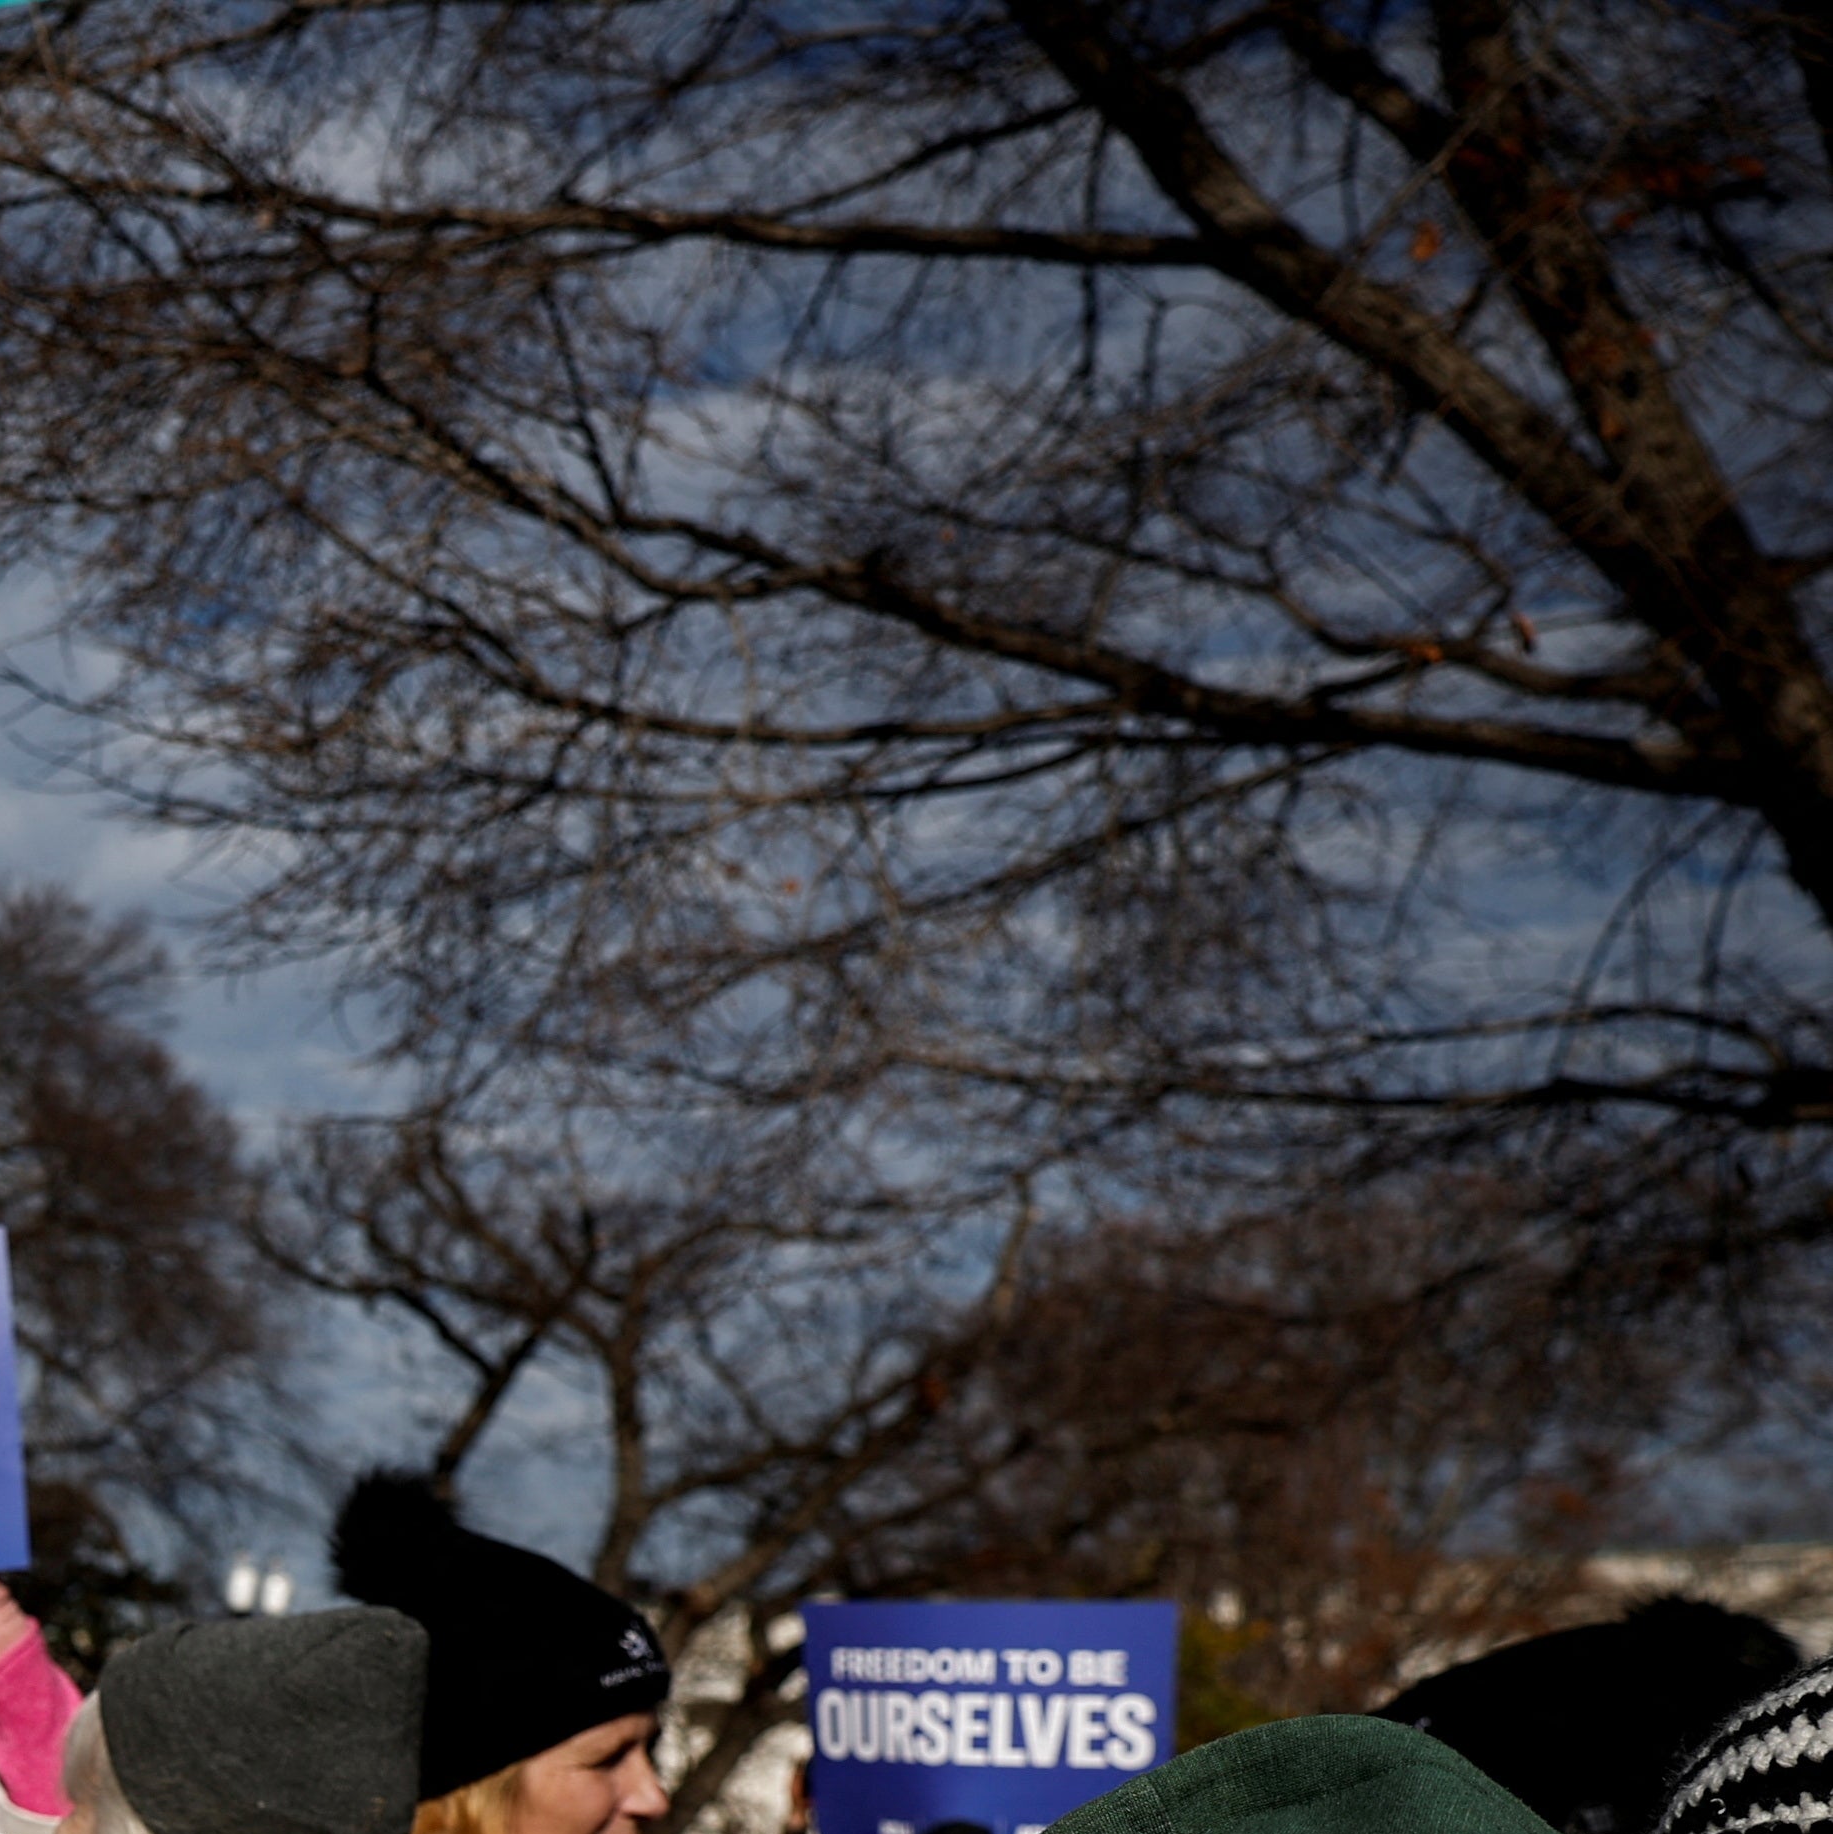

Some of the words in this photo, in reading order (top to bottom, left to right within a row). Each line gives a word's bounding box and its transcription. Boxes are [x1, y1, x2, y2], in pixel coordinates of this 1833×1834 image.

[831, 1646, 996, 1684] FREEDOM
[1002, 1648, 1063, 1686] TO
[1067, 1649, 1129, 1688] BE
[816, 1687, 1158, 1771] OURSELVES
